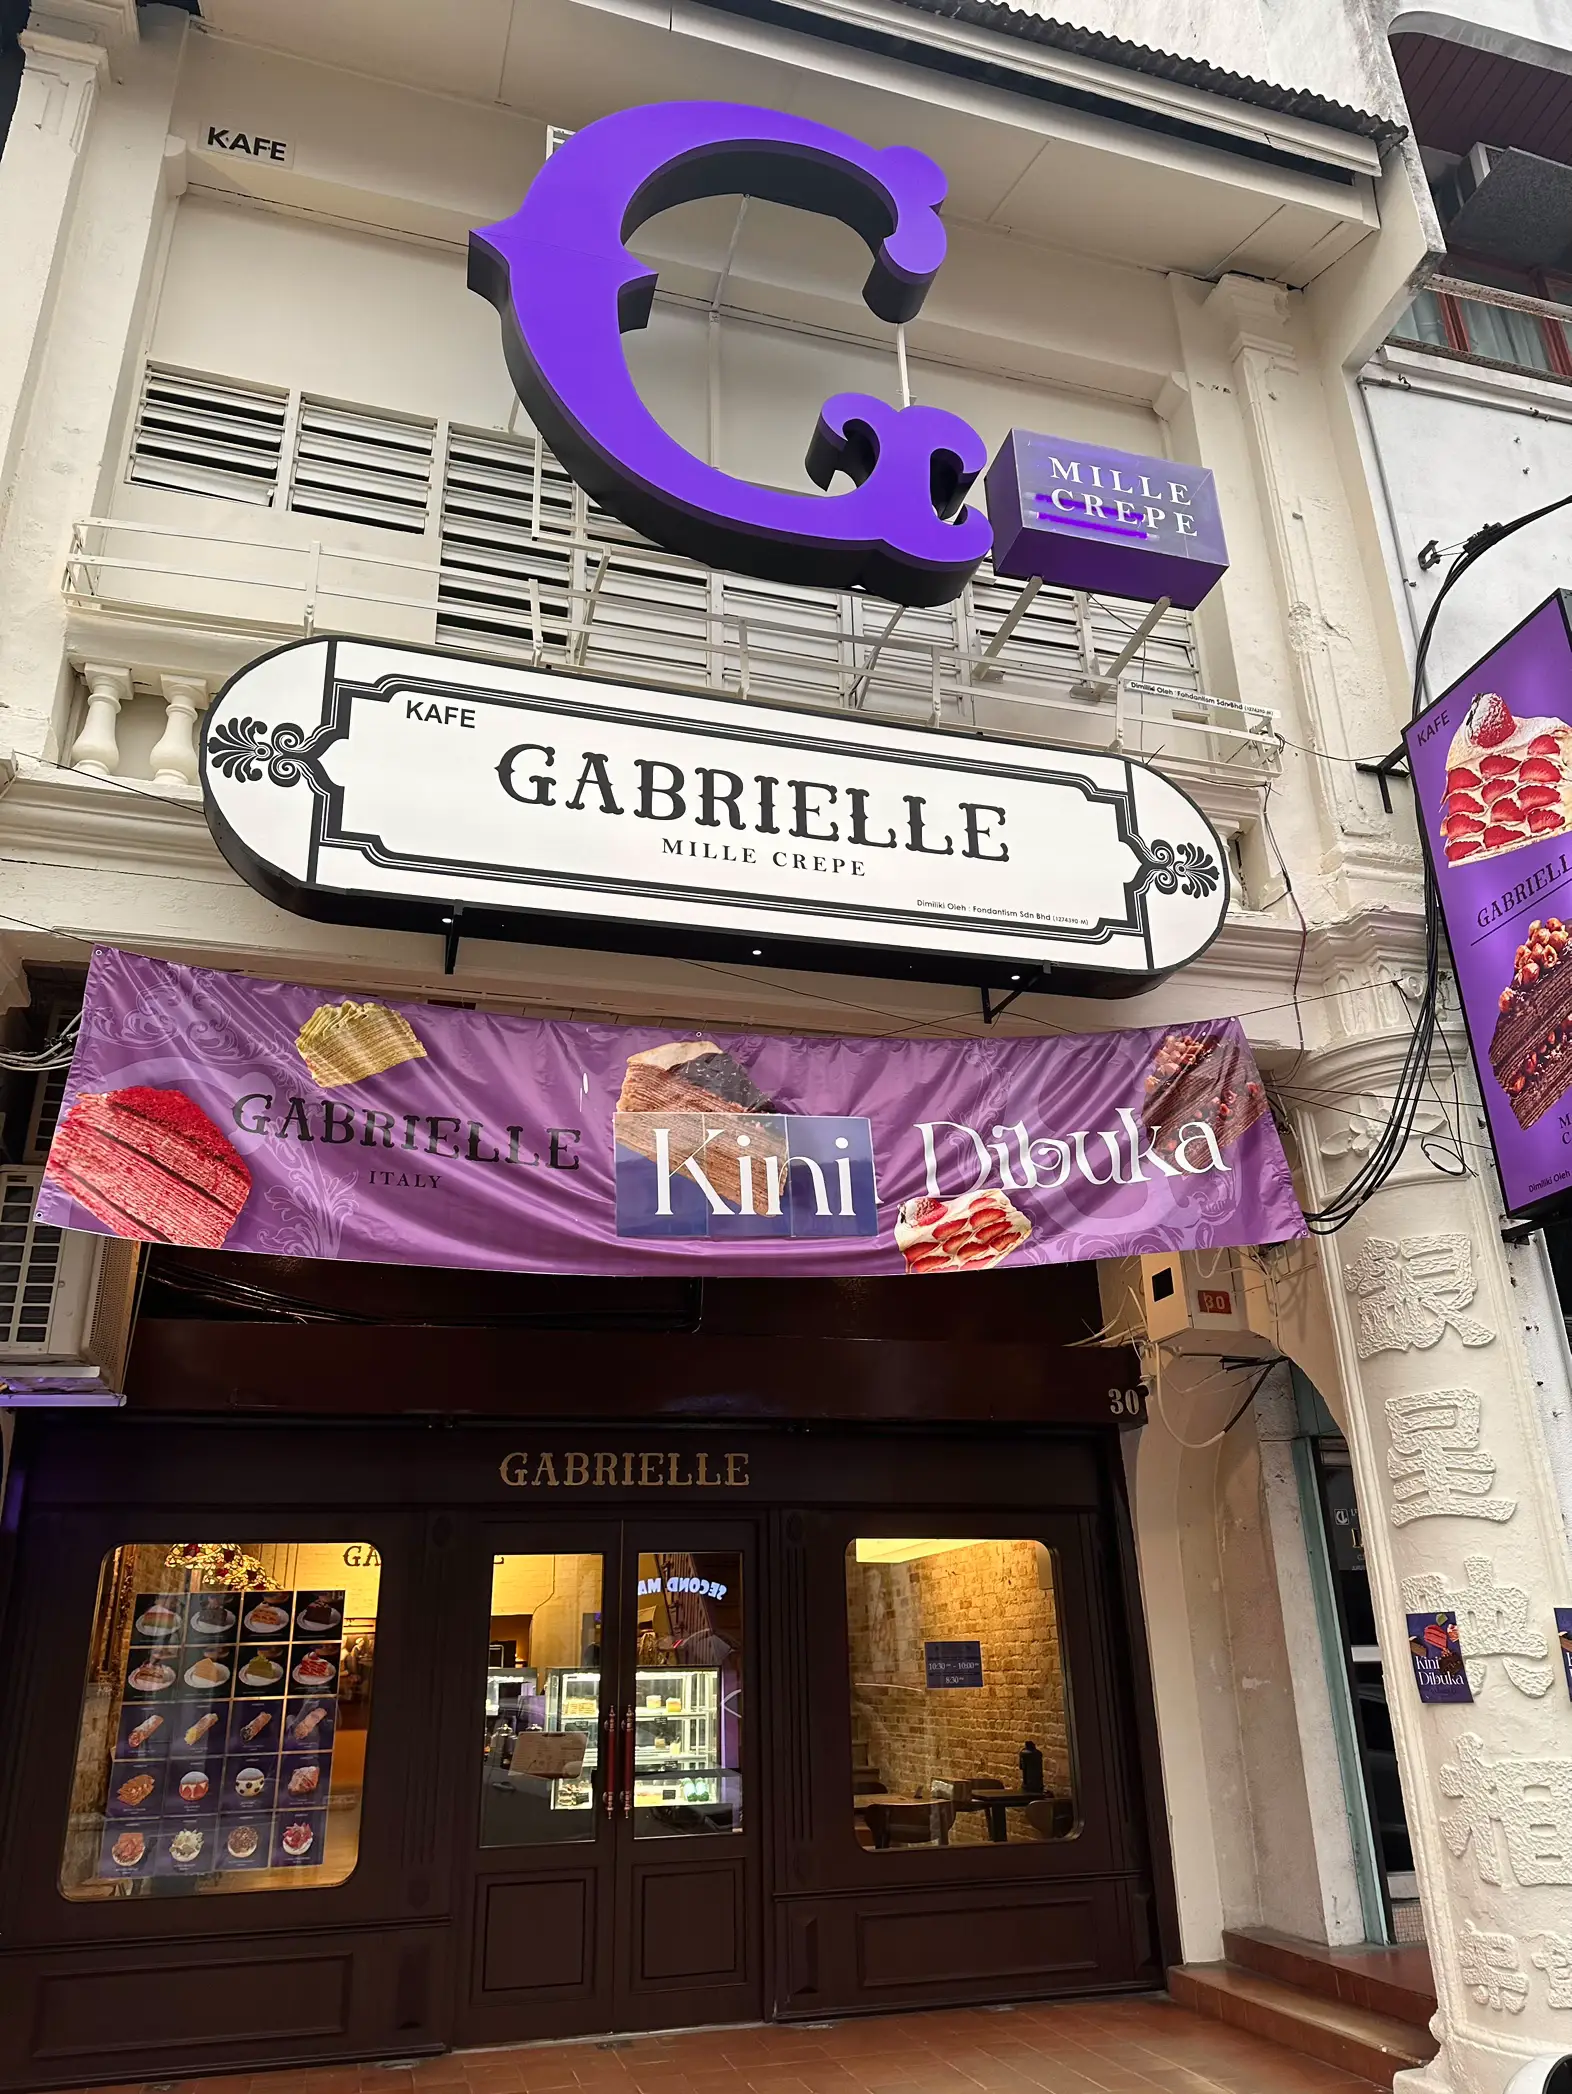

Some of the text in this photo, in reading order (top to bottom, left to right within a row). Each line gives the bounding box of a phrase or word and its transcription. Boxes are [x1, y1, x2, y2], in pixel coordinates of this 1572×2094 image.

[207, 126, 287, 162] KAFE
[1048, 456, 1192, 506] MILLE
[1051, 488, 1198, 537] CREPE
[405, 700, 476, 729] KAFE
[1416, 709, 1451, 747] KAFE
[494, 743, 1010, 862] GABRIELLE
[661, 837, 867, 877] MILLE CREPE
[916, 899, 946, 910] Dimiliki
[947, 902, 967, 912] Oleh
[972, 905, 1018, 917] Fondantism
[1019, 909, 1034, 919] Sdn
[1036, 912, 1051, 921] Bhd
[231, 1093, 582, 1171] GABRIELLE
[653, 1107, 1233, 1216] Kini Dibuka
[368, 1170, 443, 1190] ITALY
[1528, 1169, 1571, 1193] Dimiliki Oleh
[1204, 1291, 1226, 1311] 30
[1108, 1388, 1140, 1415] 30
[498, 1452, 750, 1486] GABRIELLE
[1415, 1655, 1441, 1670] Kini
[1418, 1671, 1465, 1686] Dibuka
